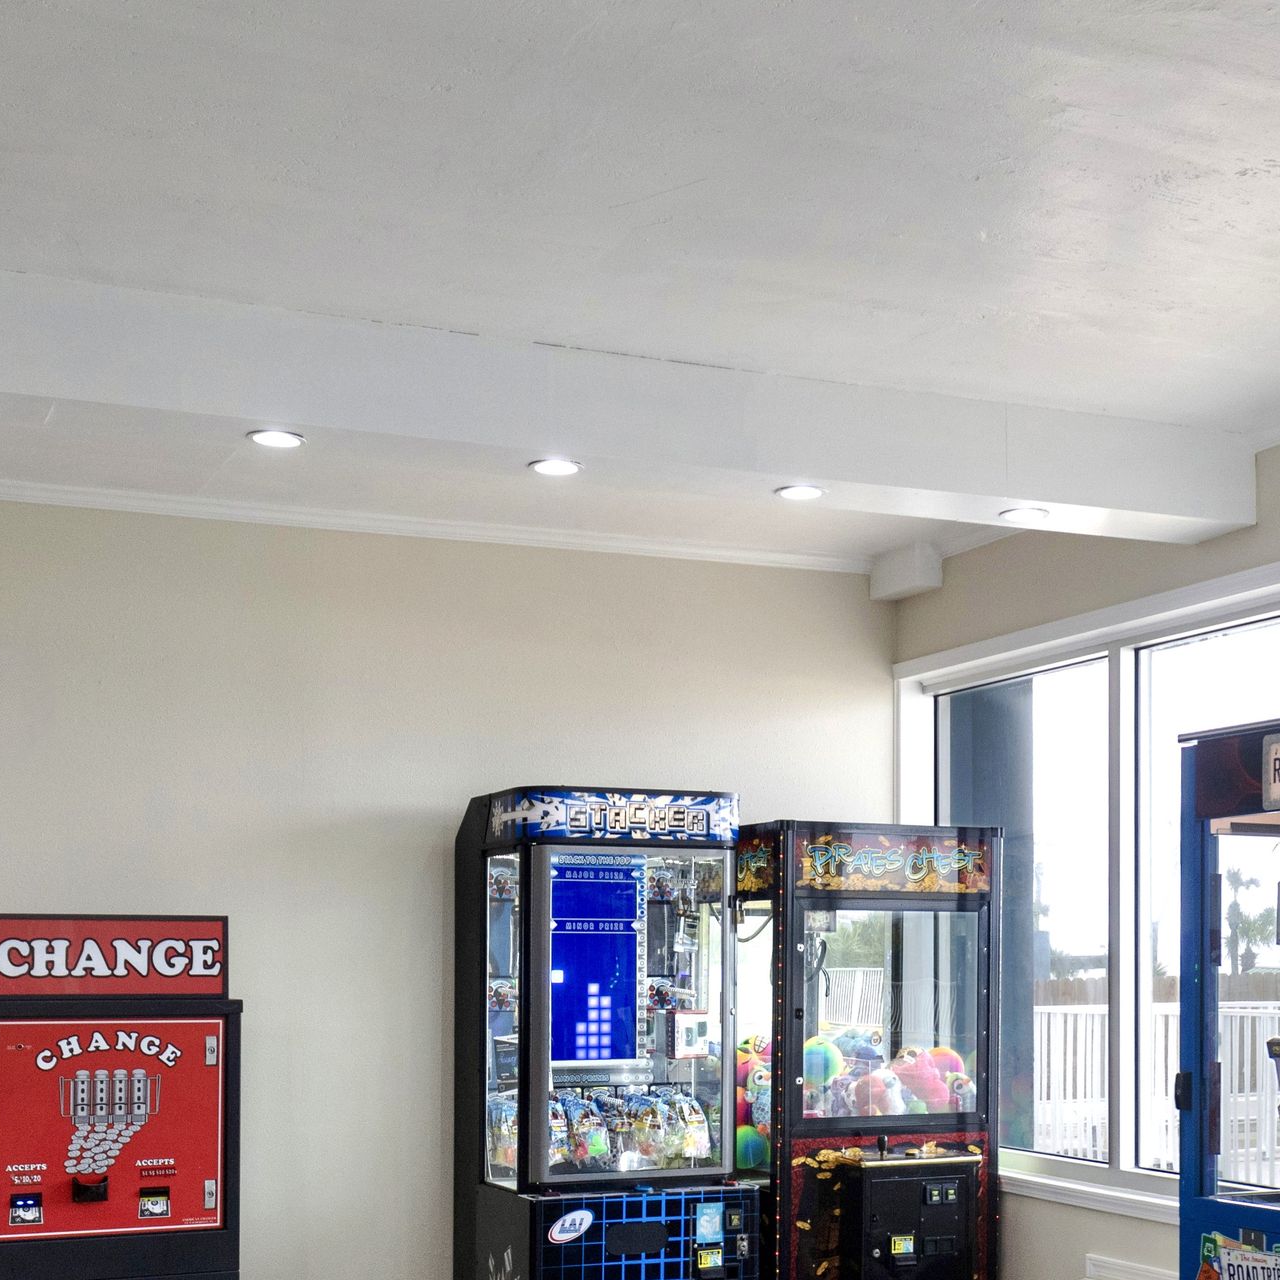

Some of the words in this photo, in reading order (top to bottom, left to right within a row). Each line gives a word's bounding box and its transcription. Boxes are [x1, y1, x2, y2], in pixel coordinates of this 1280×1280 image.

[568, 801, 708, 834] STACKER
[558, 855, 585, 865] STACK
[807, 842, 905, 877] PIRATES
[905, 845, 983, 882] CHEST
[565, 870, 595, 879] MAJOR
[598, 870, 624, 880] PRIZE
[565, 922, 595, 931] MINOR
[598, 922, 624, 931] PRIZE
[35, 1030, 182, 1071] CHANGE
[135, 1158, 175, 1166] ACCEPTS
[5, 1163, 48, 1172] ACCEPTS
[561, 1216, 585, 1230] LAI
